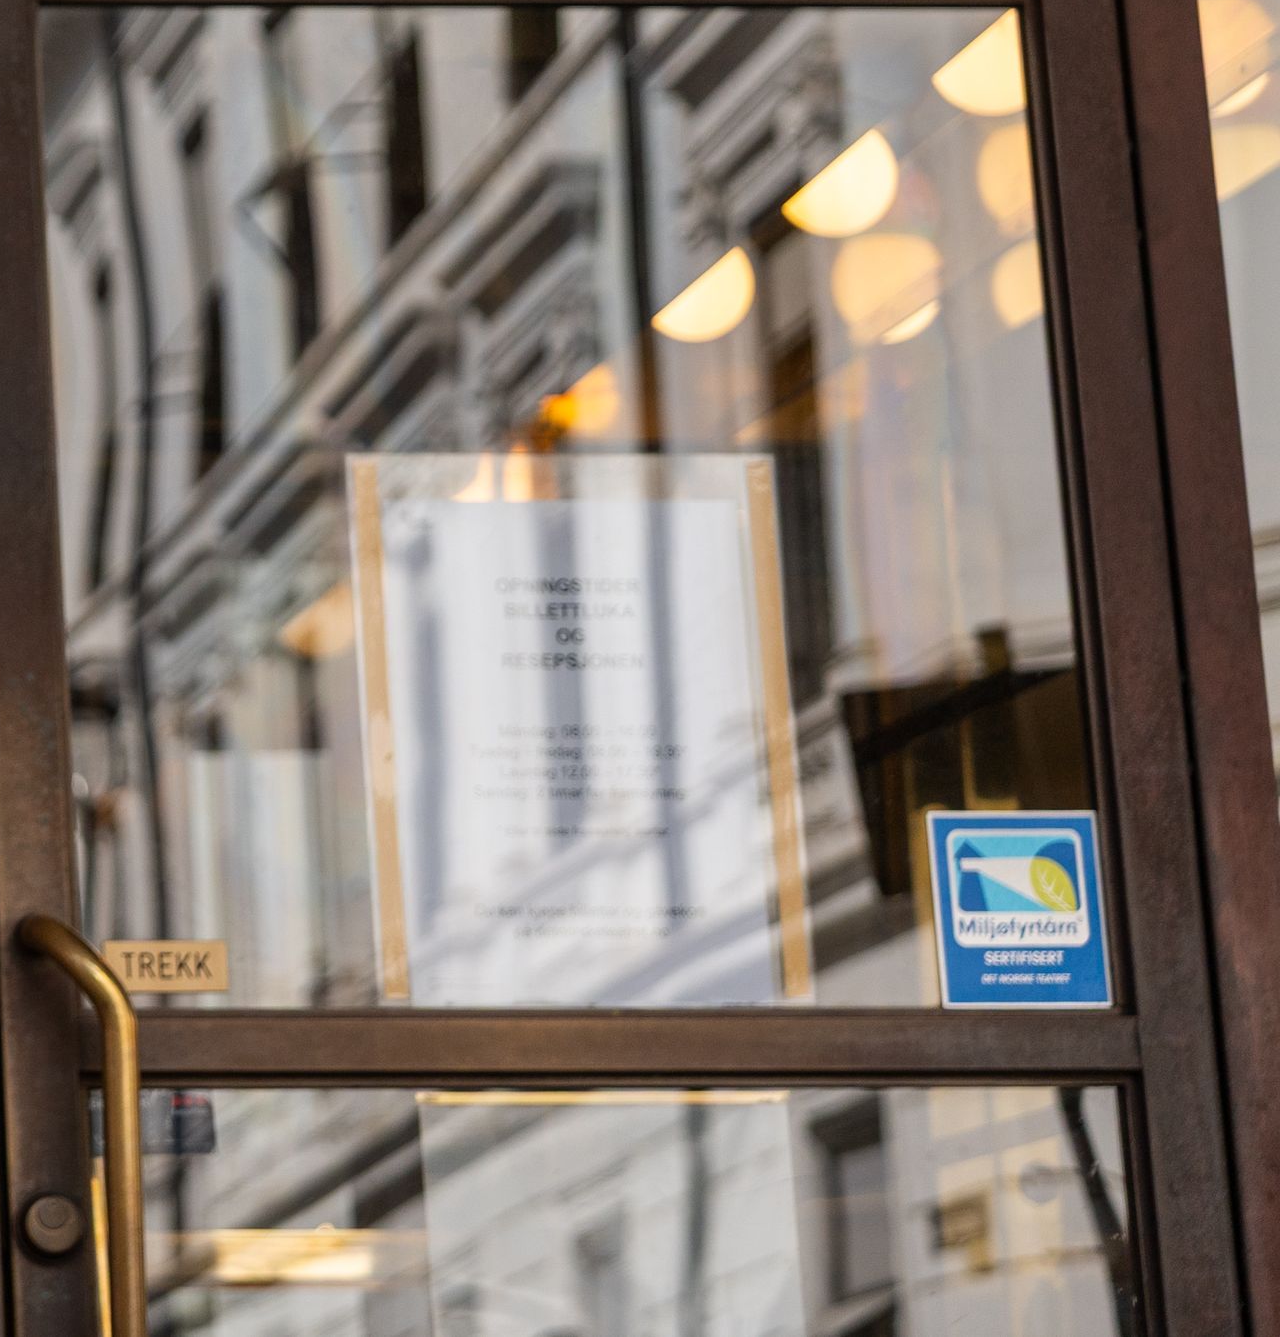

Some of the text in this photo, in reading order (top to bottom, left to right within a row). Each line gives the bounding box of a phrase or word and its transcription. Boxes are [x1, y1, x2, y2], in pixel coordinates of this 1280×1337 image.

[555, 627, 585, 645] OG
[121, 951, 213, 981] TREKK
[983, 950, 1065, 966] SERTIFISERT
